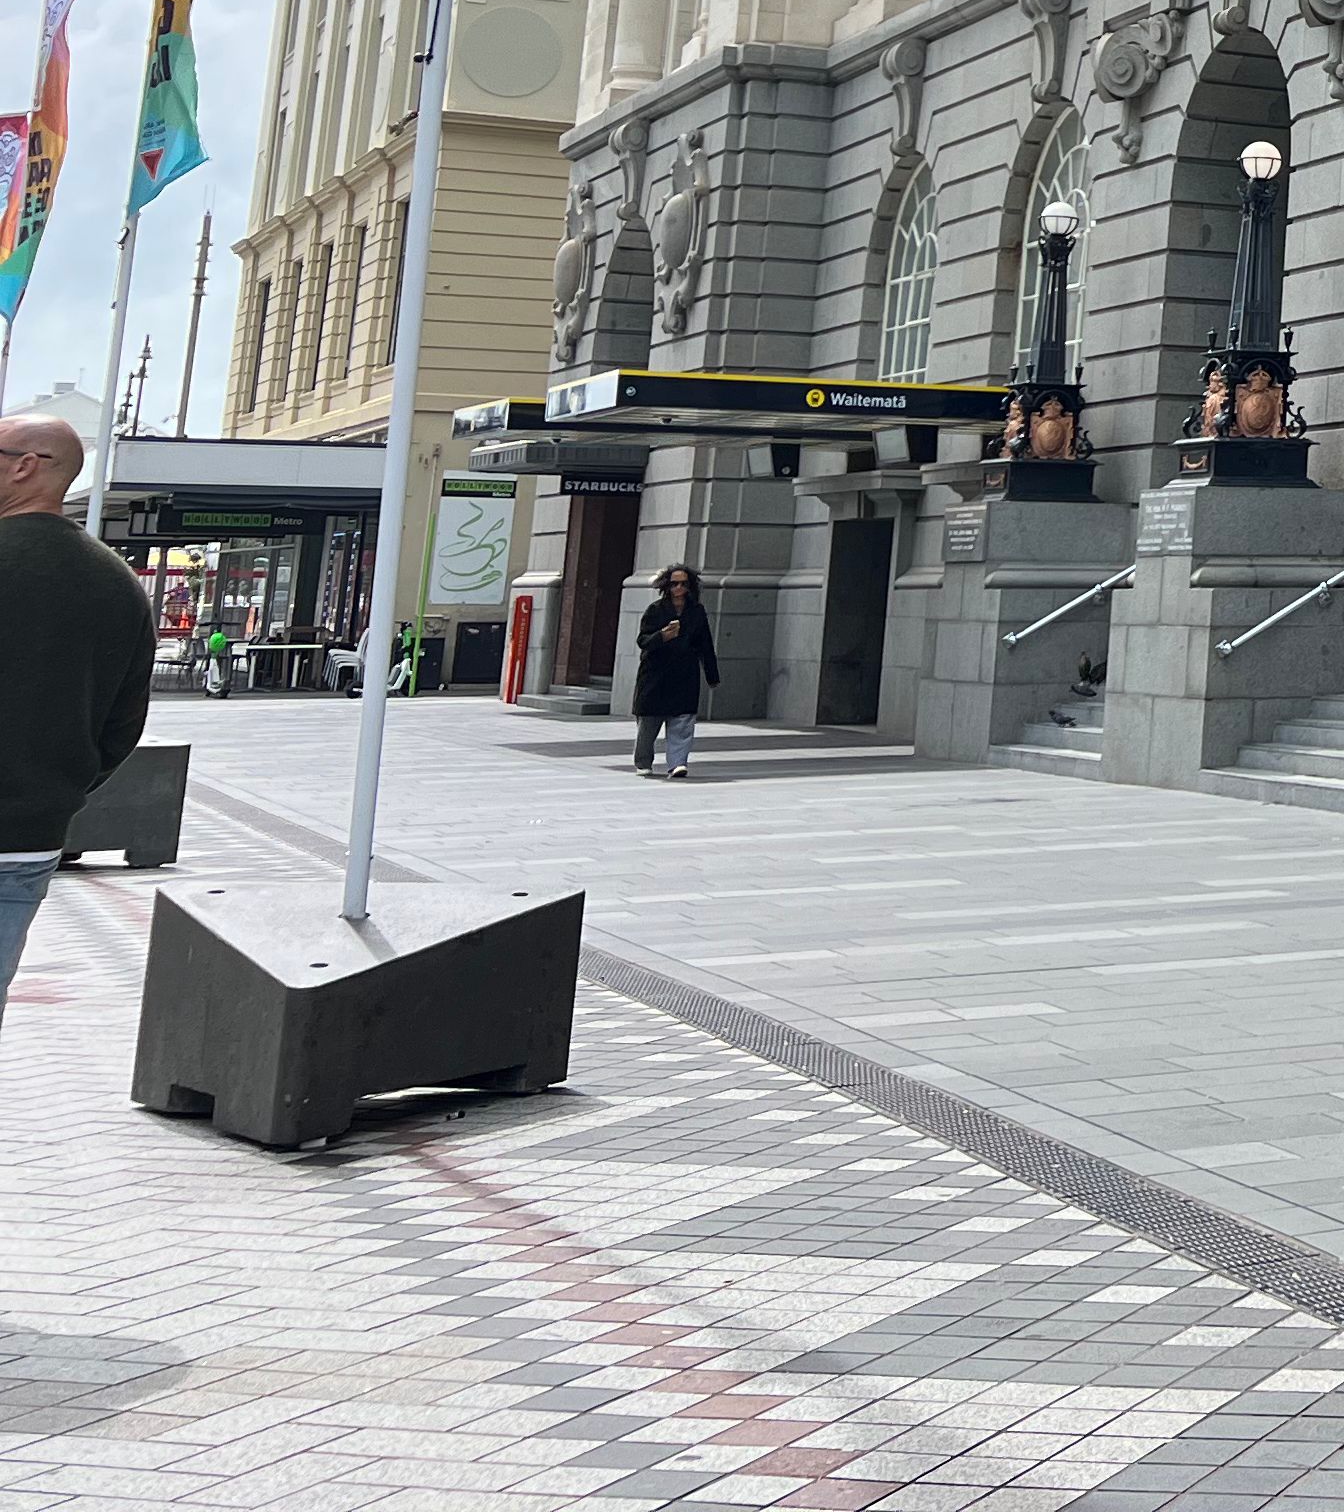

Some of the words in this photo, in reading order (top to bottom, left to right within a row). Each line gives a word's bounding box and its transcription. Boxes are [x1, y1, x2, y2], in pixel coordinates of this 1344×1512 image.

[830, 392, 907, 409] Waitematā
[564, 480, 644, 493] STARBUCKS
[183, 513, 270, 526] HOLLYWOOD
[273, 517, 304, 526] Metro
